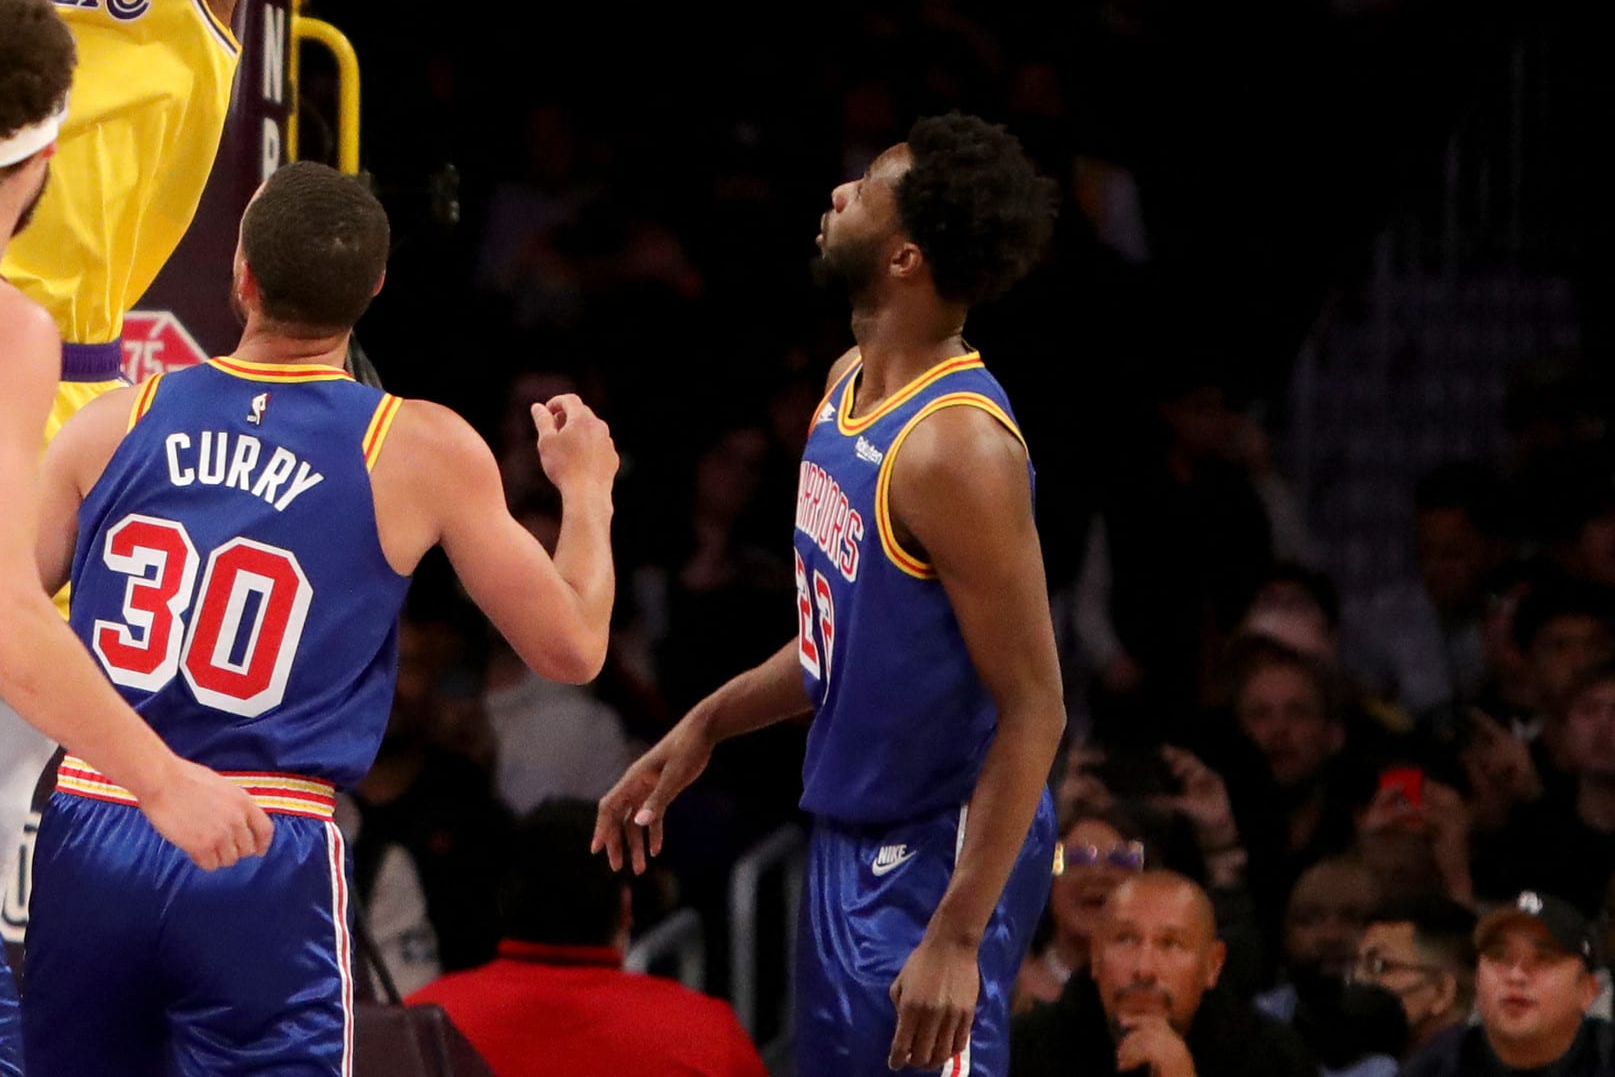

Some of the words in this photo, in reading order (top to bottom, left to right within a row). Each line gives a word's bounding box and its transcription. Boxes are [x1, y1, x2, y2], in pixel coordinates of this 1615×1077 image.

[124, 340, 164, 386] 75
[166, 431, 325, 512] CURRY
[92, 513, 314, 718] 30
[877, 844, 907, 864] NIKE
